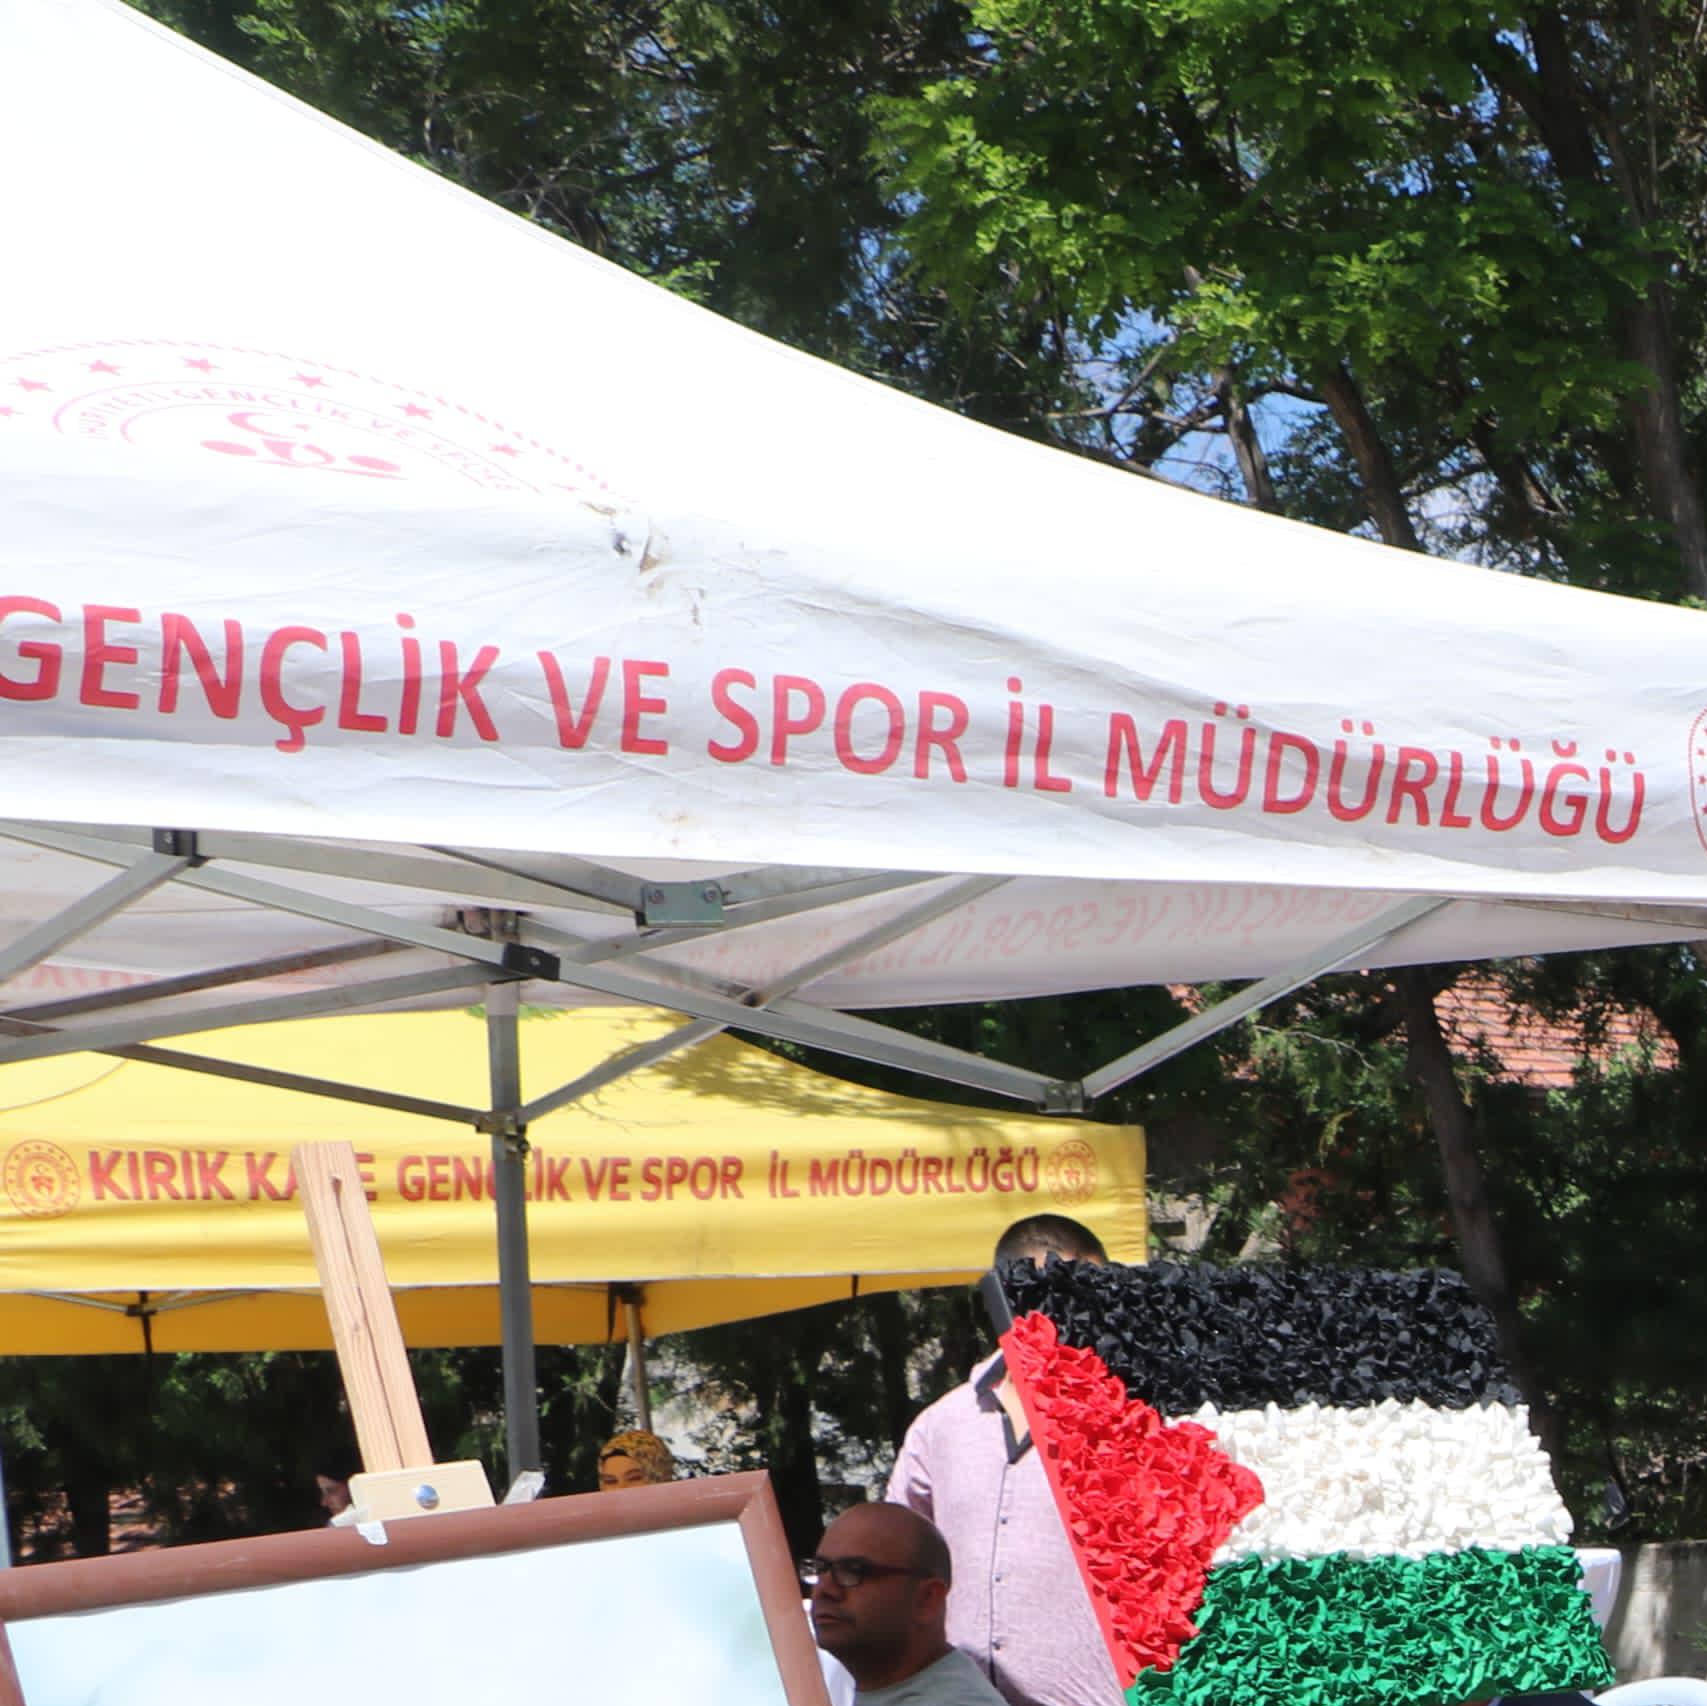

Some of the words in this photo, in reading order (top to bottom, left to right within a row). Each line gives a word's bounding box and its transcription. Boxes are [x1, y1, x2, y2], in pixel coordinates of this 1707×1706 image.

[0, 594, 501, 753] GENÇLİK
[536, 650, 671, 757] VE
[707, 667, 970, 784] SPOR
[1001, 676, 1074, 795] İL
[1102, 701, 1648, 846] MÜDÜRLÜĞÜ
[87, 1149, 238, 1201] KIRIK
[396, 1147, 573, 1202] GENİK
[579, 1156, 632, 1202] VE
[641, 1155, 744, 1202] SPOR
[768, 1149, 801, 1199] İL
[808, 1145, 1040, 1197] MÜDÜRLÜĞÜ
